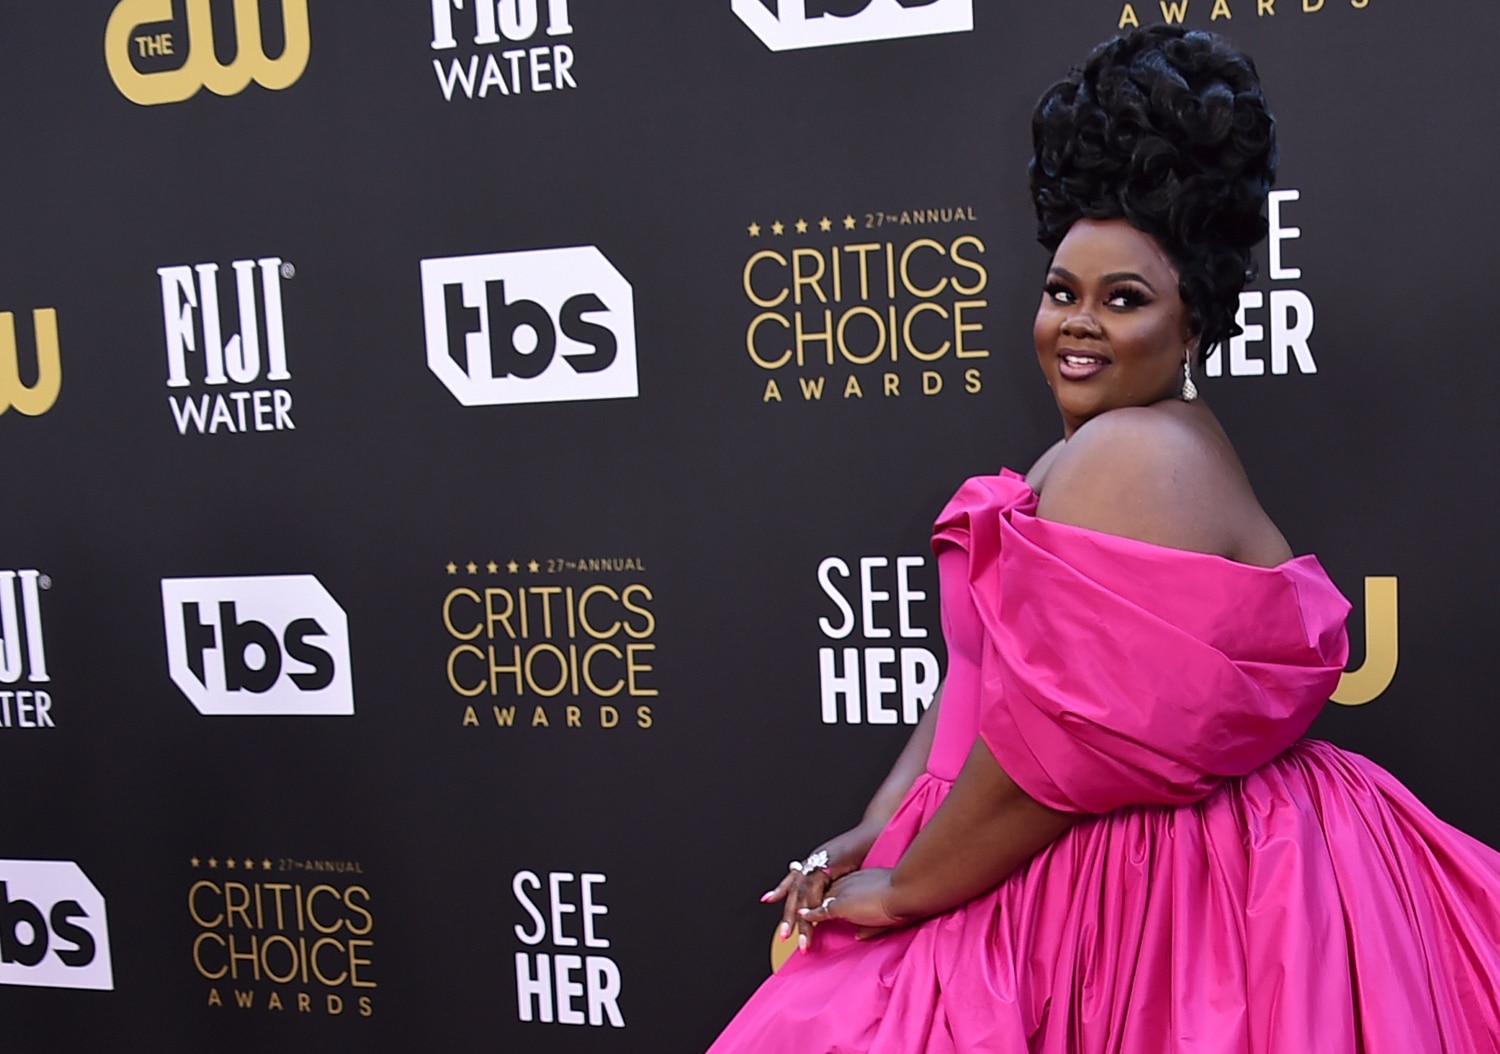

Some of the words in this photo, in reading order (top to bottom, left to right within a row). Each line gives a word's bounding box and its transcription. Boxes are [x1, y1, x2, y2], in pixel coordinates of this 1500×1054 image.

[104, 0, 311, 106] CW
[135, 34, 173, 57] THE
[433, 45, 576, 100] WATER
[899, 203, 977, 226] ANNUAL
[744, 236, 986, 307] CRITICS
[443, 280, 617, 379] tbs
[747, 301, 989, 368] CHOICE
[1206, 289, 1317, 377] ER
[169, 390, 295, 434] WATER
[764, 369, 981, 401] AWARDS
[444, 585, 654, 639] CRITICS
[818, 557, 927, 638] SEE
[182, 601, 335, 693] tbs
[448, 644, 658, 696] CHOICE
[819, 646, 941, 725] HER
[463, 706, 651, 728] AWARDS
[0, 880, 96, 967] bs
[189, 881, 372, 934] CRITICS
[513, 871, 609, 947] SEE
[194, 933, 376, 987] CHOICE
[516, 953, 625, 1027] HER
[209, 989, 371, 1016] AWARDS
